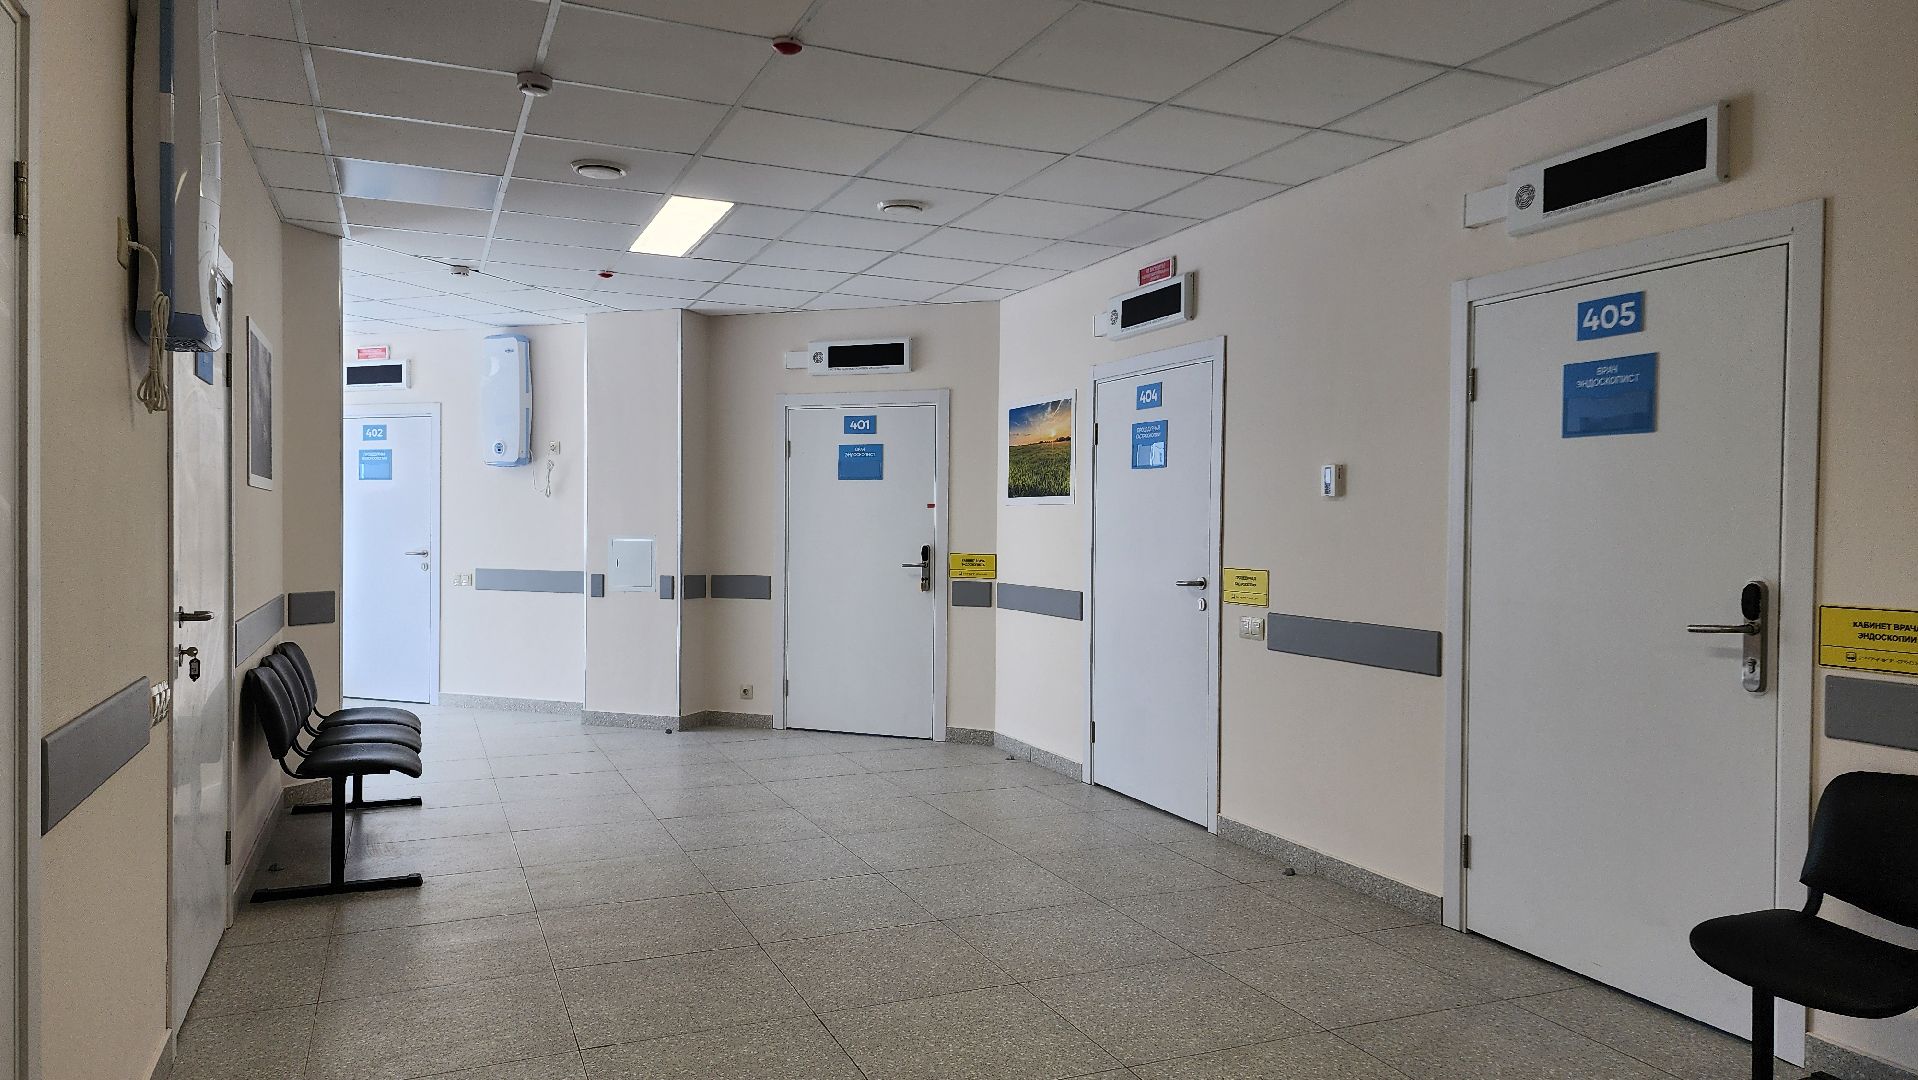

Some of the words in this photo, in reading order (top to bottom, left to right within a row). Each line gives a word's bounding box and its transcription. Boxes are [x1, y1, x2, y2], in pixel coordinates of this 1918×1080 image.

[1582, 301, 1636, 331] 405
[1596, 364, 1619, 376] ВРАЧ
[1575, 373, 1641, 388] ЭНДОСКОПИСТ
[1139, 388, 1158, 403] 404
[849, 419, 870, 430] 401
[366, 428, 384, 438] 402
[1853, 621, 1892, 631] КАБИНЕТ
[1893, 623, 1918, 633] ВРАЧ
[1857, 632, 1917, 644] ЭНДОСКОПИИ
